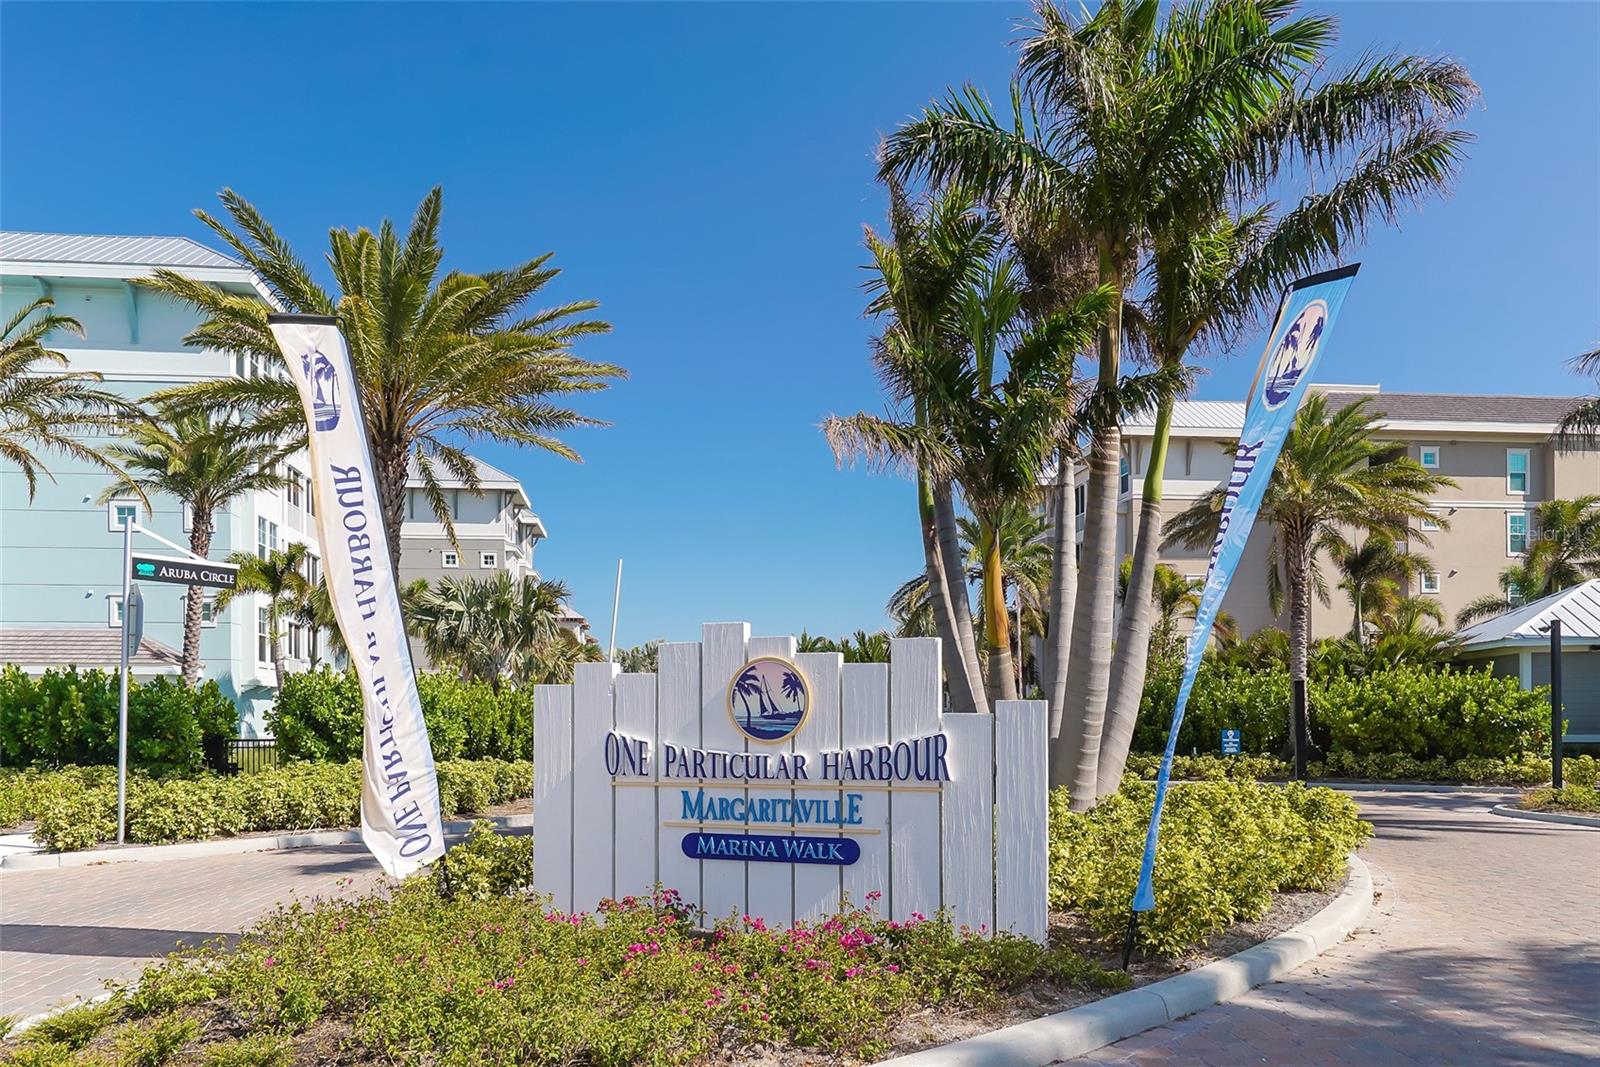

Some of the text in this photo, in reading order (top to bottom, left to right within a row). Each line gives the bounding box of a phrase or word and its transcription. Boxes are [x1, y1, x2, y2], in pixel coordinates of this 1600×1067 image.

[1205, 439, 1264, 582] BOUR
[159, 566, 198, 581] ARUBA
[200, 570, 235, 584] CIRCLE
[605, 731, 951, 781] ONE PARTICULAR HARBOUR
[681, 790, 863, 825] MARGARITAVILLE
[696, 836, 845, 861] MARINA WALK
